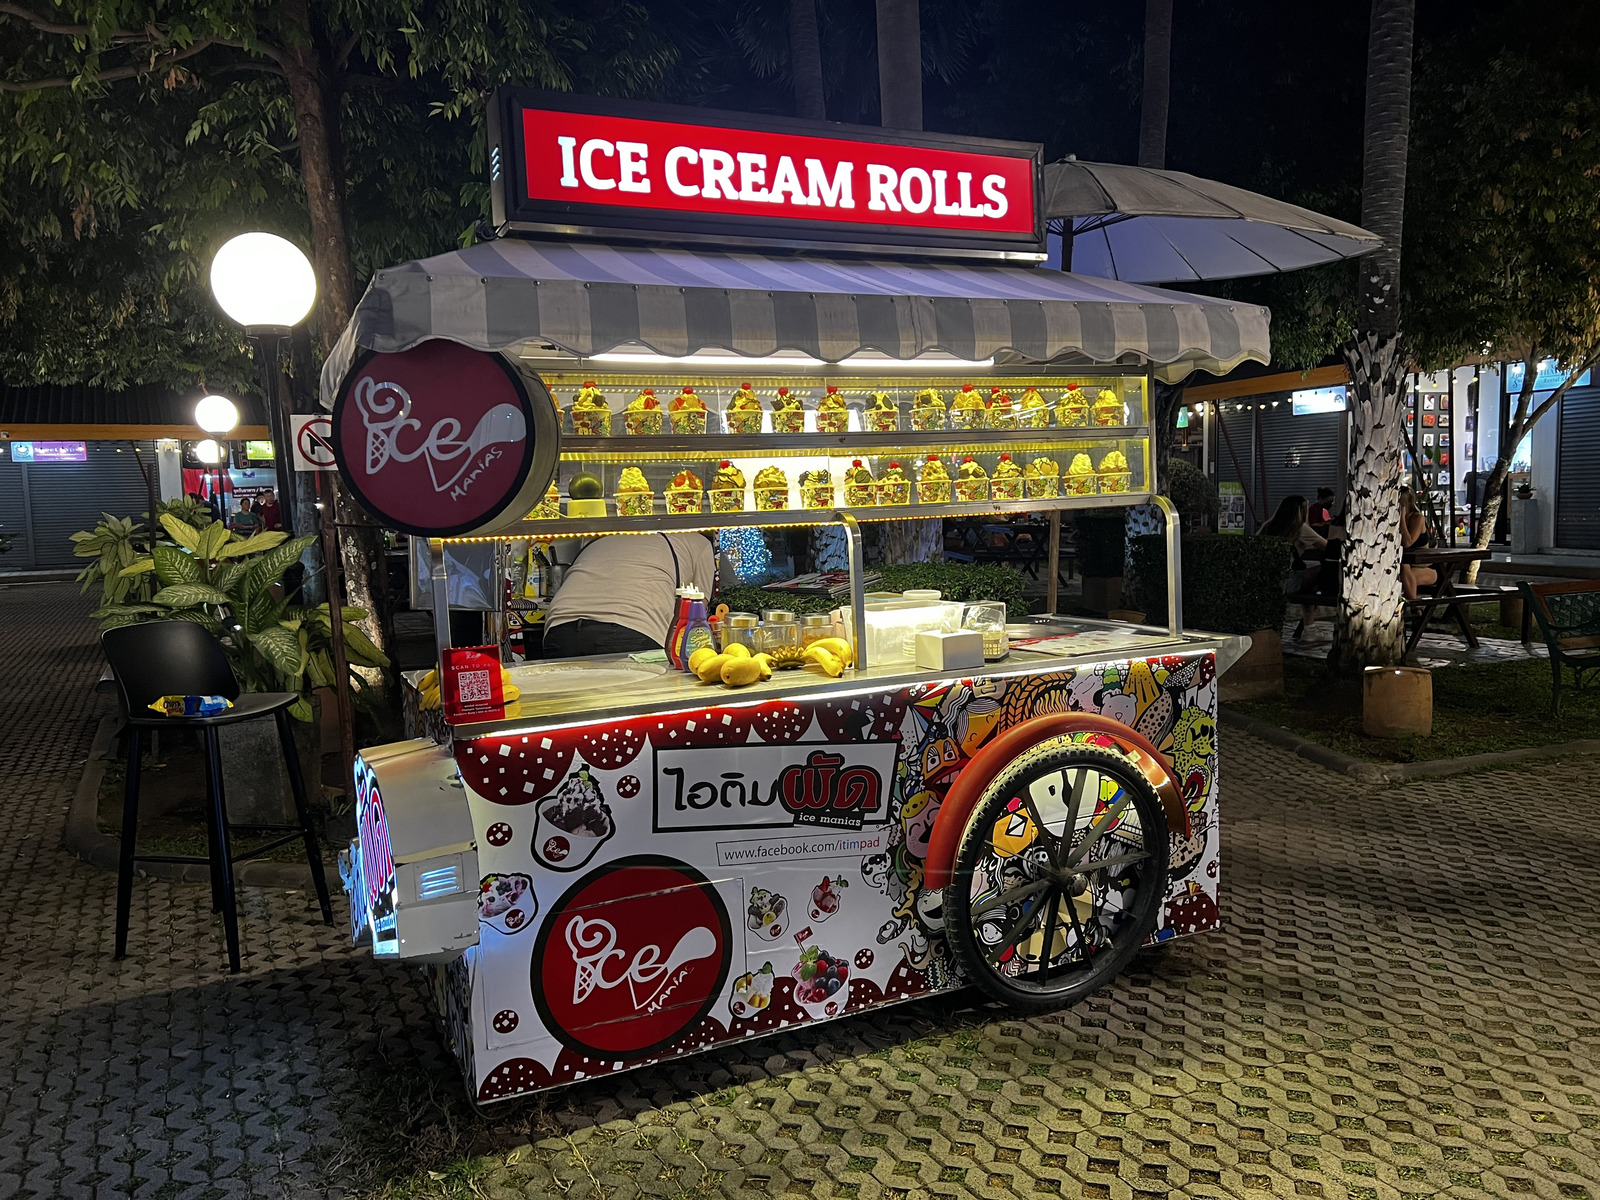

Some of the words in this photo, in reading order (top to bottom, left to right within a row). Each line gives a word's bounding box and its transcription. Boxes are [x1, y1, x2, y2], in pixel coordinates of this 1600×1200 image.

[557, 136, 651, 193] ICE
[664, 146, 855, 209] CREAM
[866, 163, 1008, 218] ROLLS
[799, 812, 816, 822] ice
[819, 814, 861, 827] manias
[724, 836, 880, 861] www.facebook.com/itimpad
